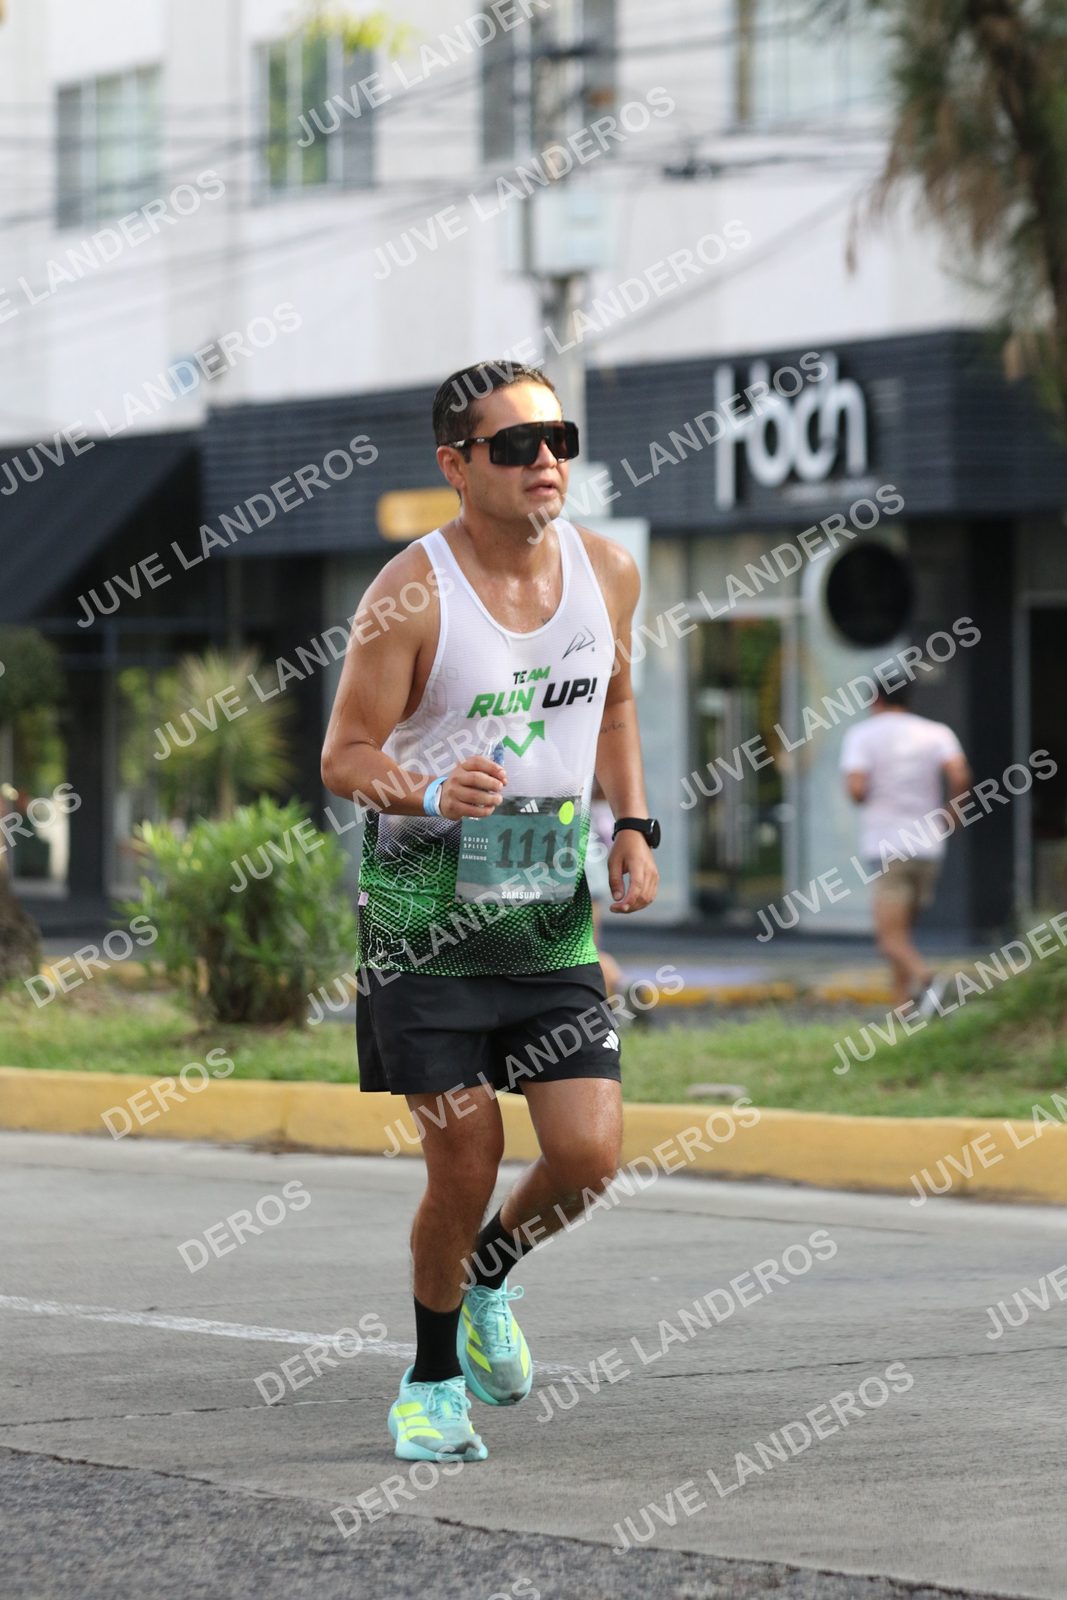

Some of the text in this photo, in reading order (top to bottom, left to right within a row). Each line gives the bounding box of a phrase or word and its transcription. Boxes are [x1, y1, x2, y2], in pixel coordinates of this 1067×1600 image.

[513, 666, 551, 684] TEAM
[467, 677, 598, 718] RUN UP!
[495, 828, 574, 869] 1111
[501, 891, 541, 899] SAMSUNG
